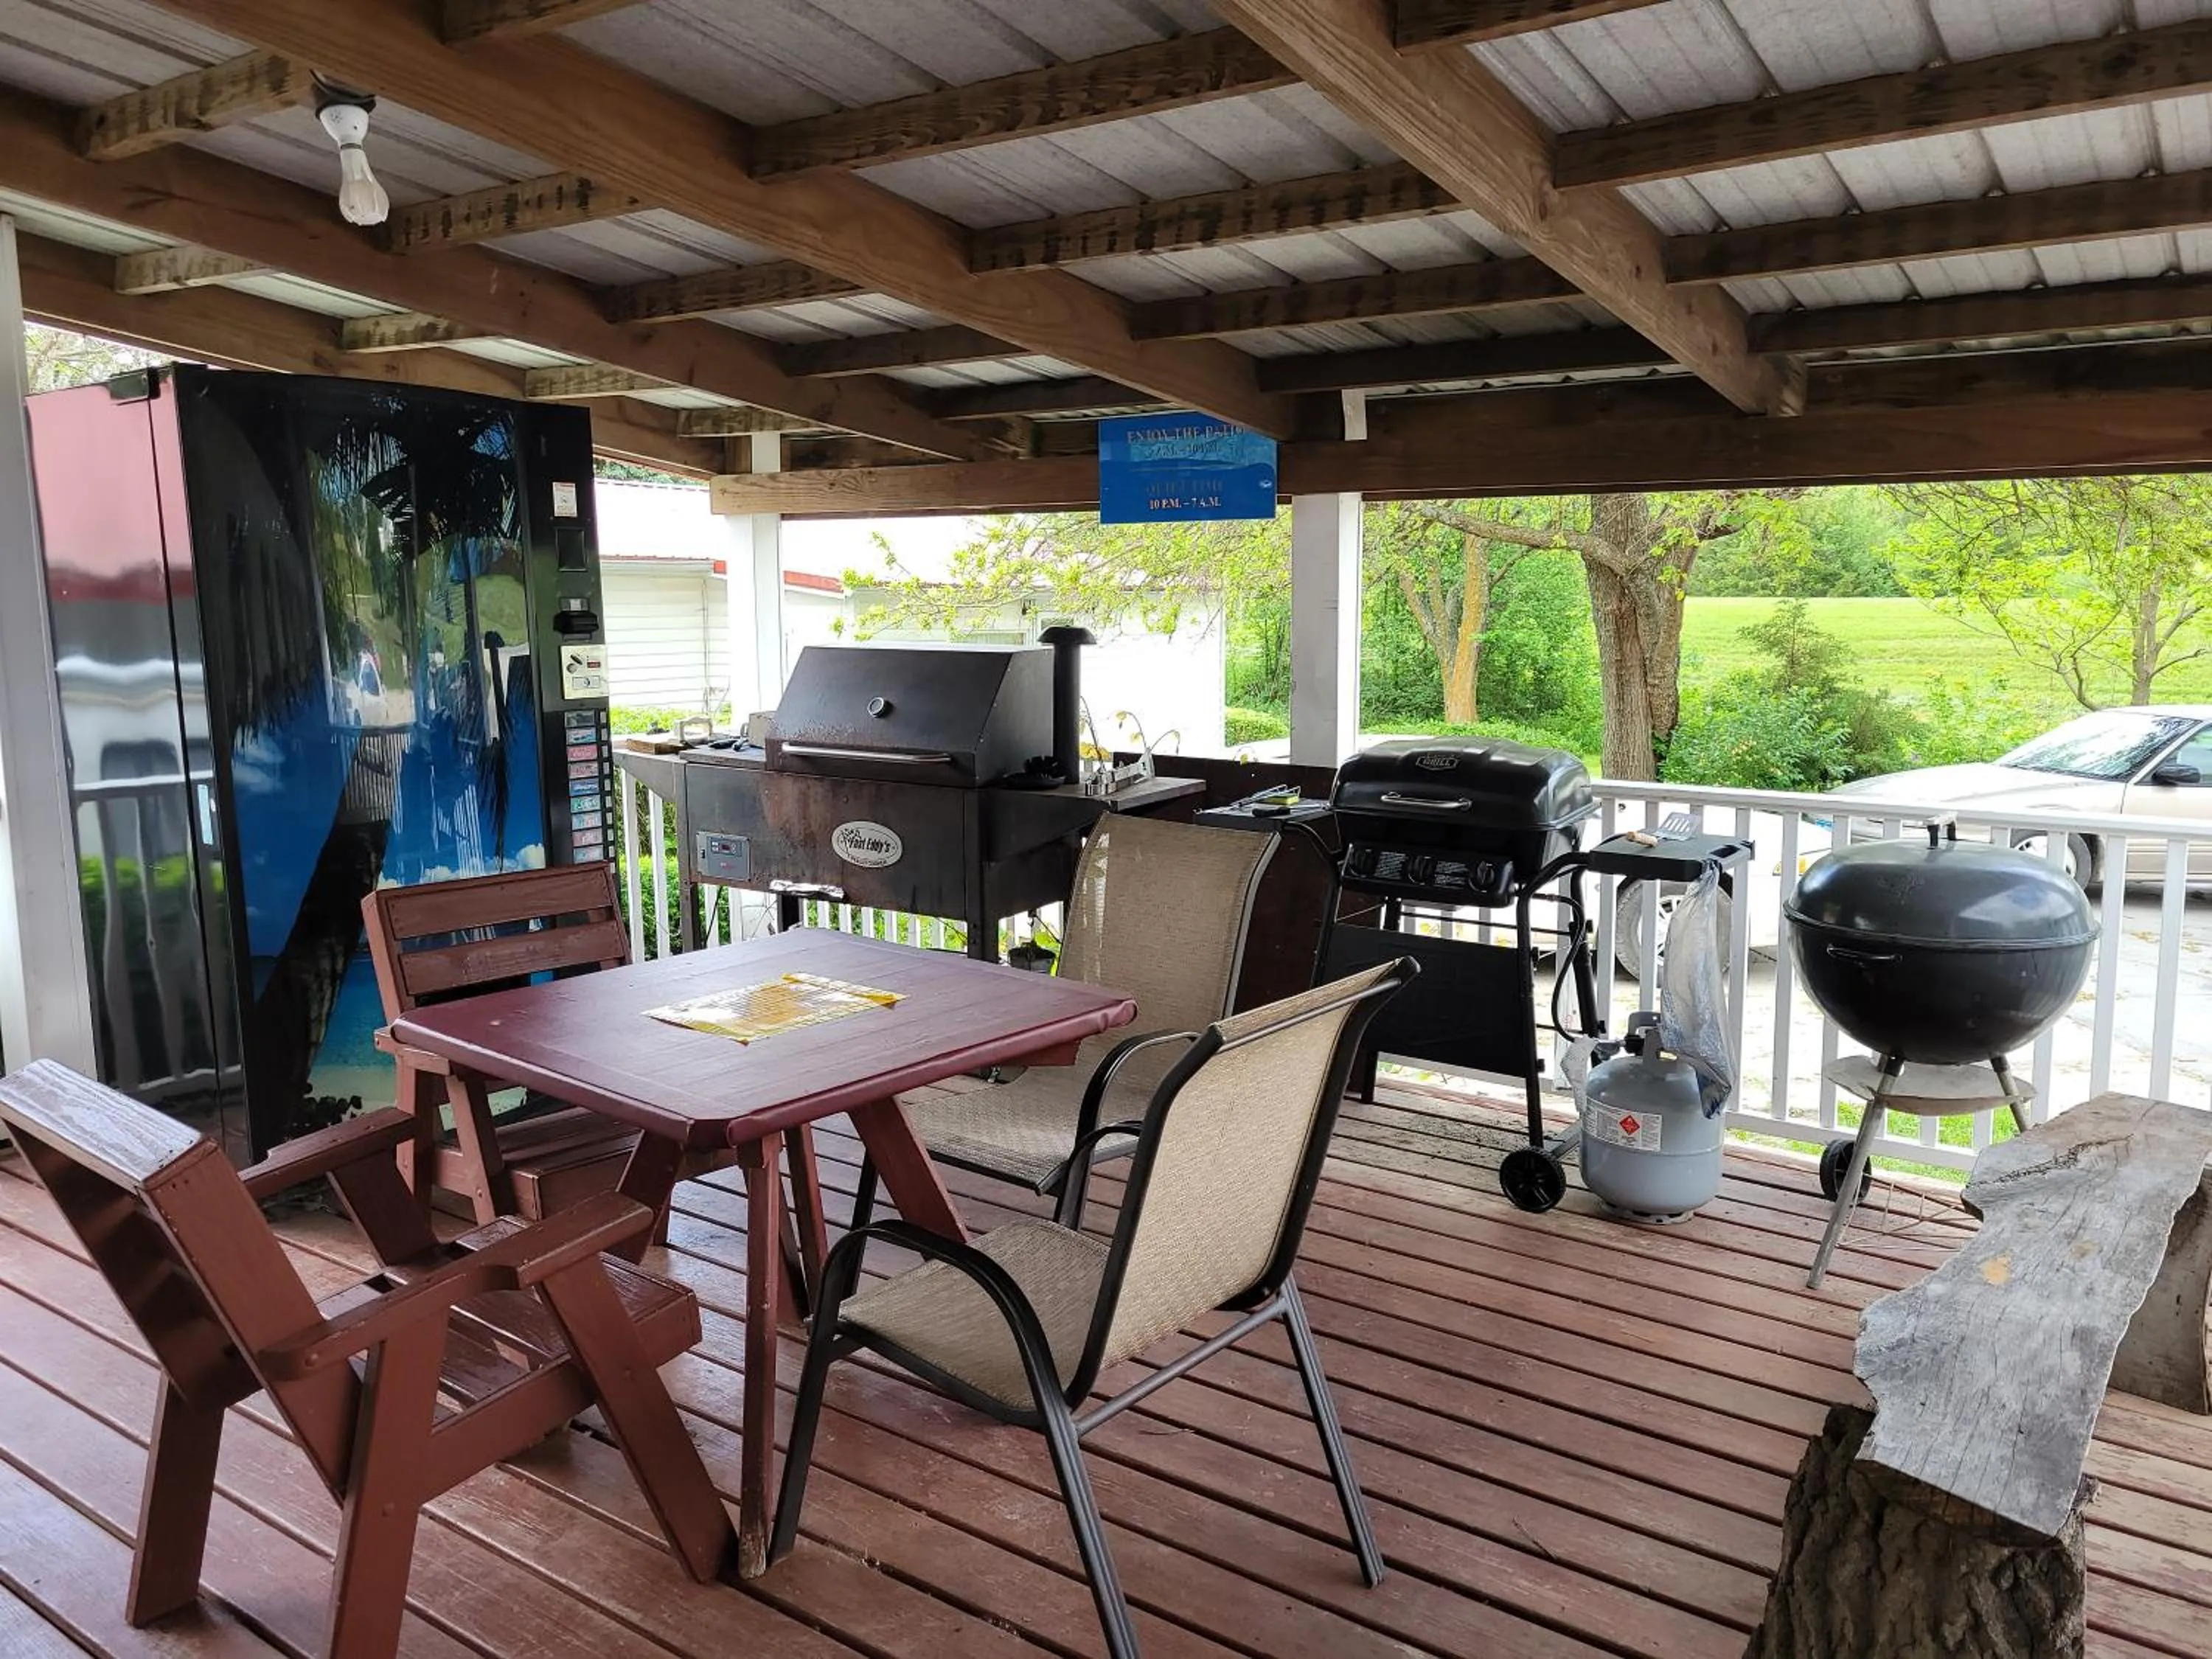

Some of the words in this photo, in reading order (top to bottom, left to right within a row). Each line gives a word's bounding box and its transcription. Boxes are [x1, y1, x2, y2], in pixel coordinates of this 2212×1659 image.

[1175, 426, 1202, 440] THE
[1150, 499, 1160, 509] 10
[1191, 497, 1197, 508] 7
